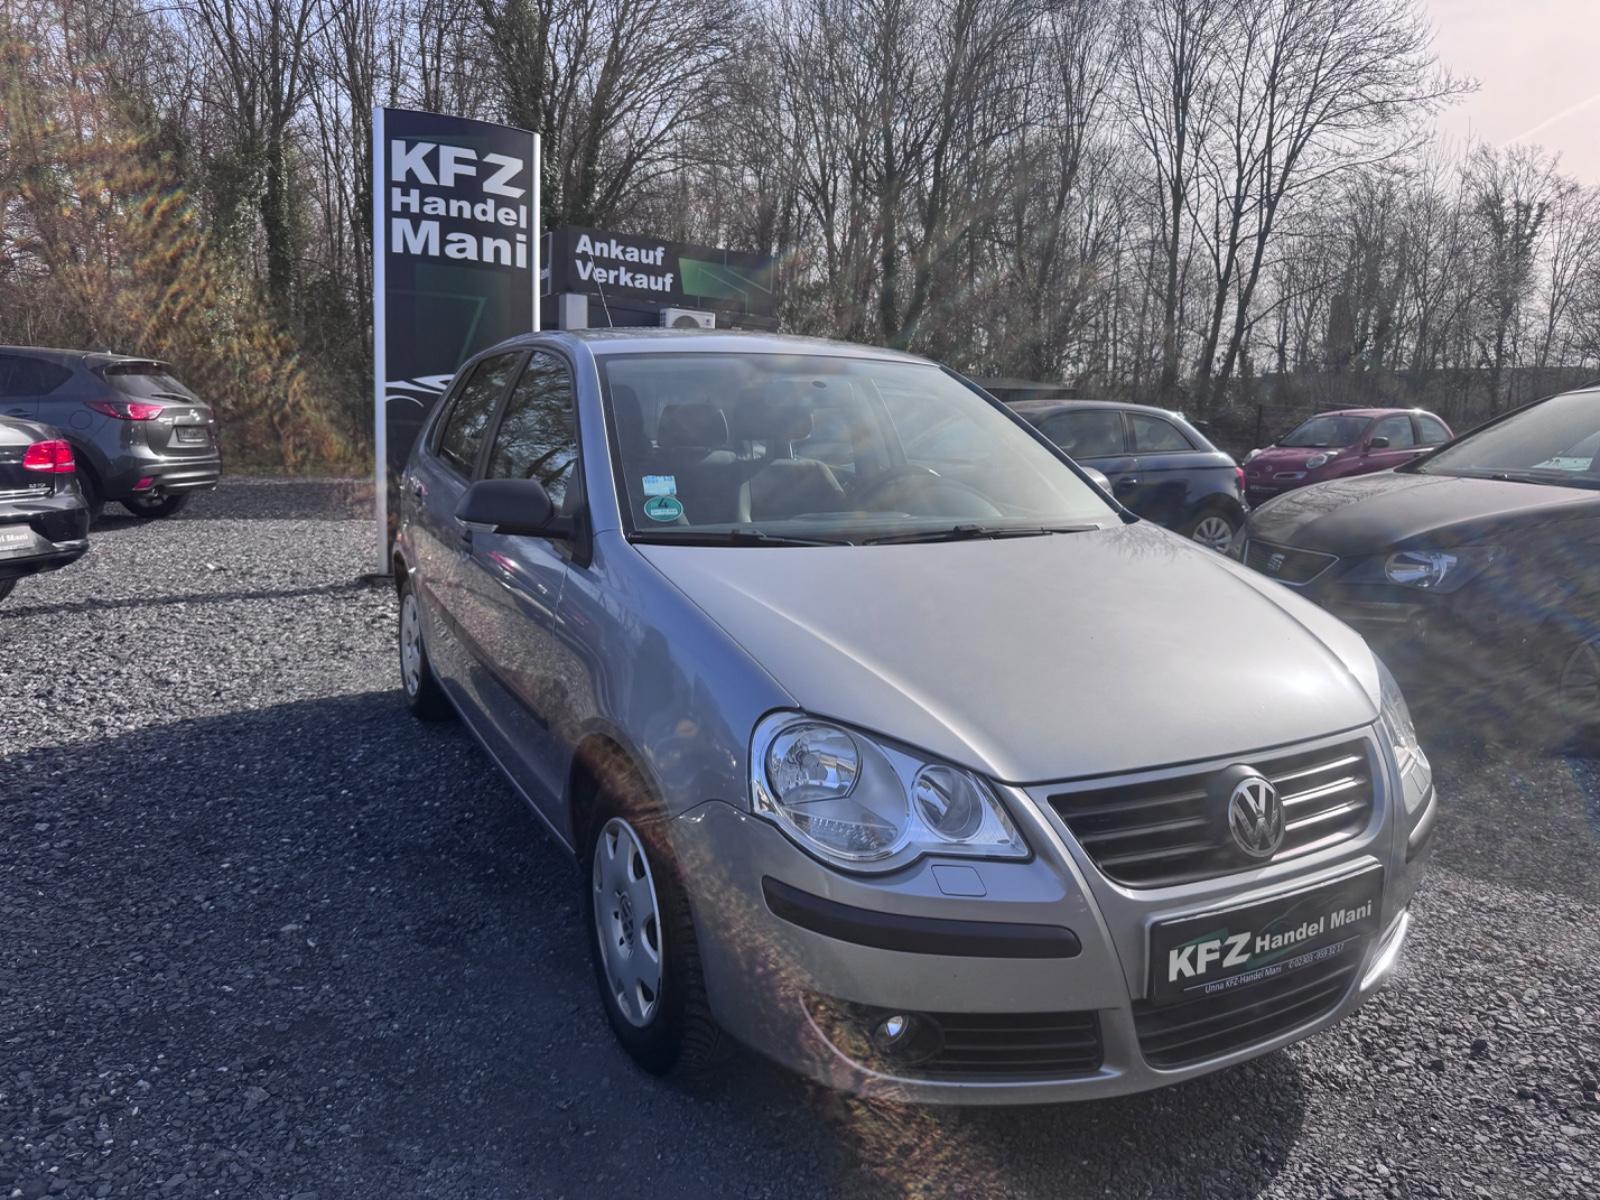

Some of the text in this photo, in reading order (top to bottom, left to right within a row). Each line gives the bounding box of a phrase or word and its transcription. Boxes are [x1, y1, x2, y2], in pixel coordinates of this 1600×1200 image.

[391, 139, 526, 198] KFZ
[391, 187, 527, 229] Handel
[391, 218, 527, 269] Mani
[575, 234, 665, 266] Ankauf
[575, 259, 674, 292] Verkauf
[1168, 900, 1372, 983] KFZ Handel Mani
[1205, 982, 1225, 993] Unna
